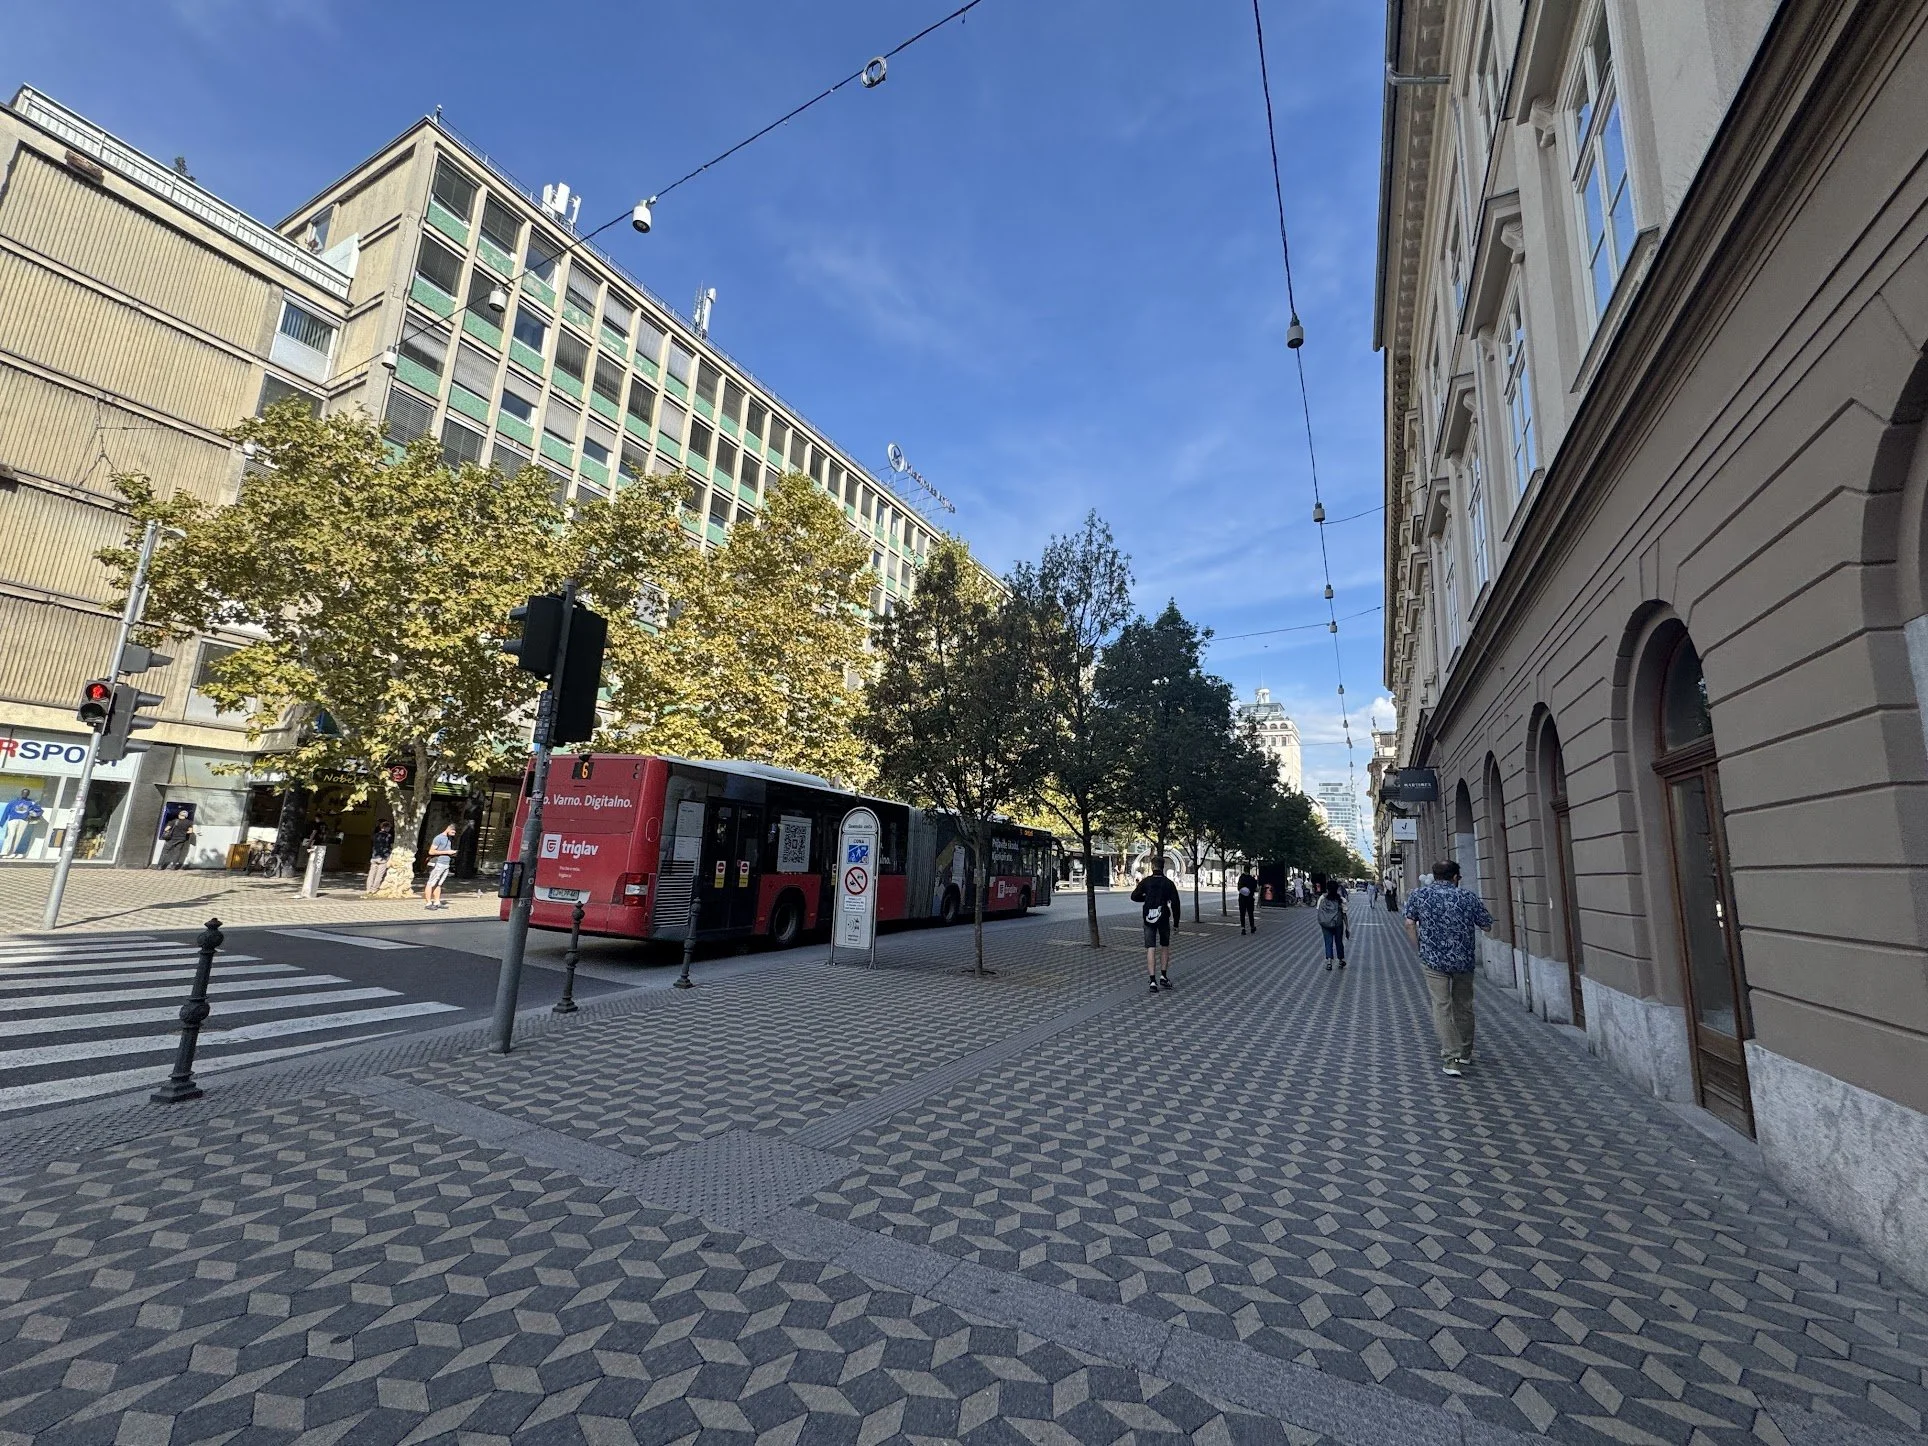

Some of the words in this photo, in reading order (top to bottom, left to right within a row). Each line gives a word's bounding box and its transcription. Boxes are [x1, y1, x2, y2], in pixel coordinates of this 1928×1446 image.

[394, 769, 404, 777] 24
[581, 762, 589, 778] 6
[553, 794, 582, 806] Varno.
[584, 795, 633, 810] Digitalno.
[562, 840, 599, 859] triglav
